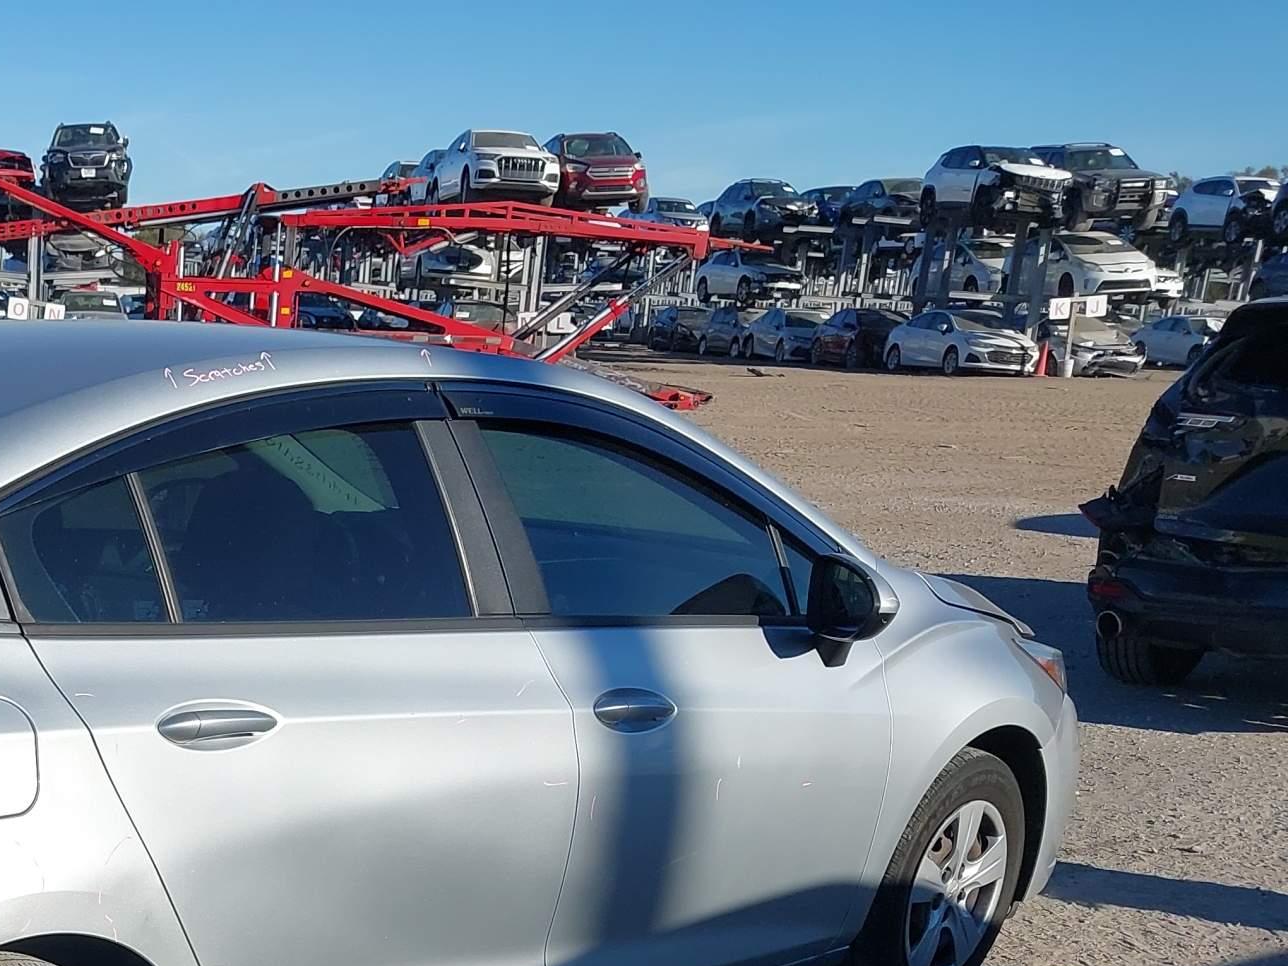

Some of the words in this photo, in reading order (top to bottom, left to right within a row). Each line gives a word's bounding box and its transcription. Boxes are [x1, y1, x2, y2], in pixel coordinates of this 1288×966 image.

[1054, 302, 1065, 316] K
[556, 317, 565, 330] L
[183, 361, 265, 387] Scratches
